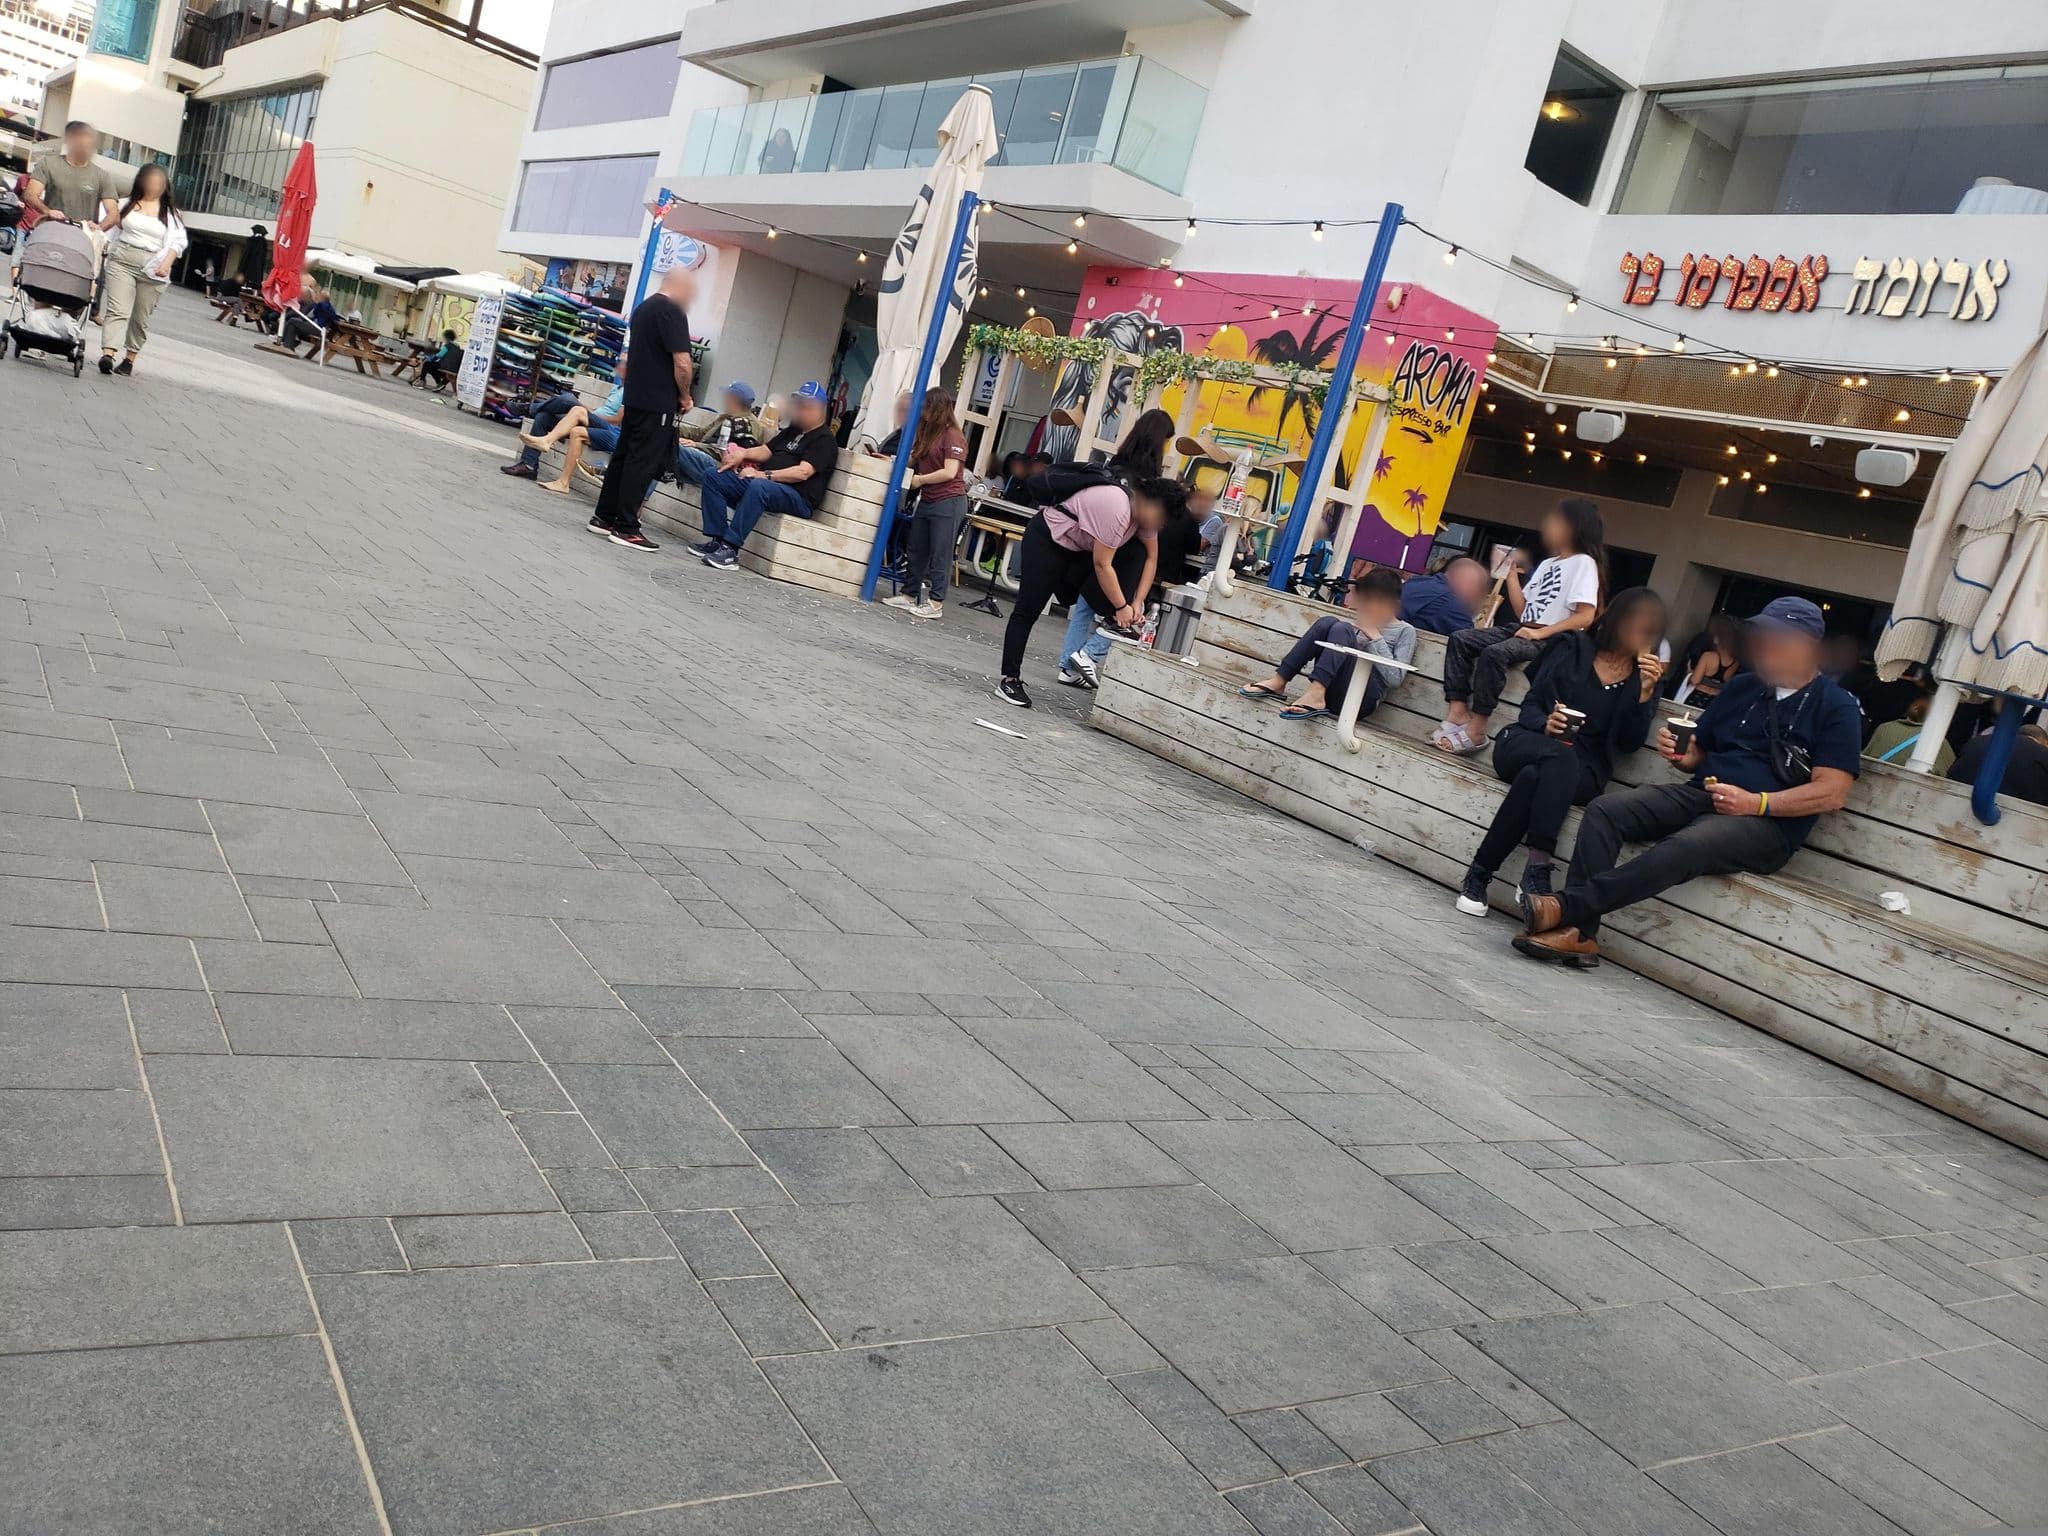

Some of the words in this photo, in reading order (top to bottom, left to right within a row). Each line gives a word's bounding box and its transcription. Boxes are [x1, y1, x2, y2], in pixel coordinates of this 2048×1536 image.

[1620, 250, 1665, 306] בר
[1675, 254, 1829, 312] אספרסו
[1844, 256, 2009, 321] ארומה
[1393, 340, 1477, 426] AROMA
